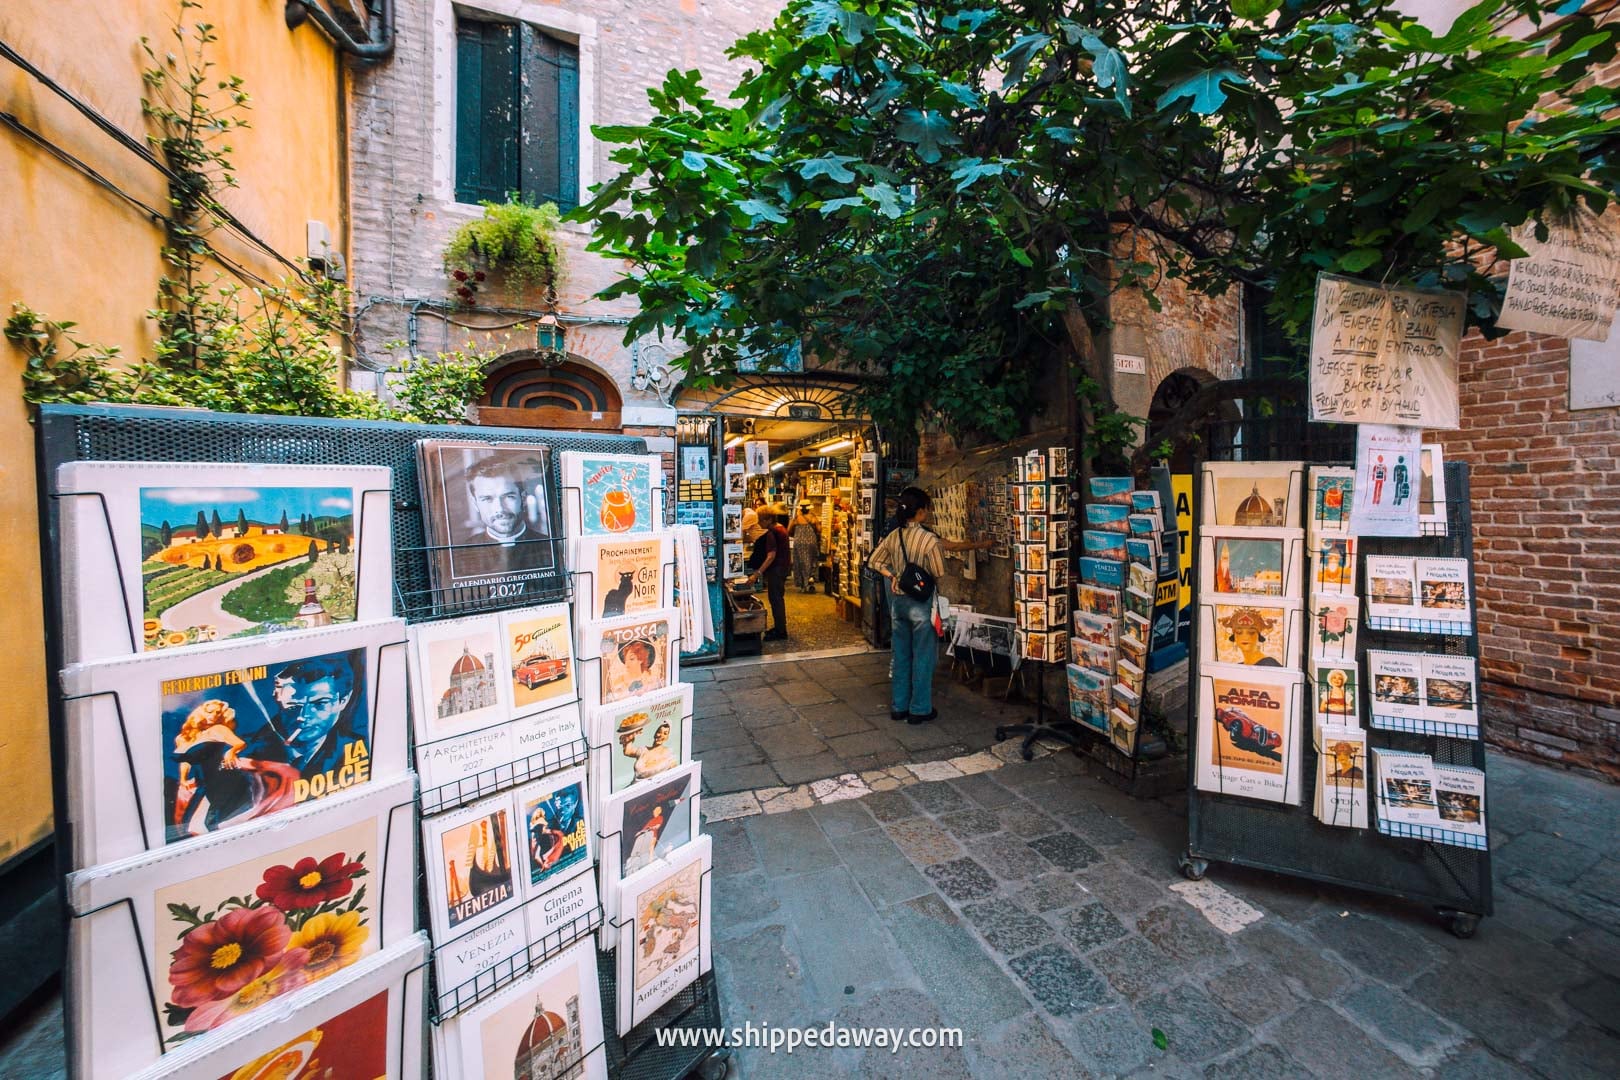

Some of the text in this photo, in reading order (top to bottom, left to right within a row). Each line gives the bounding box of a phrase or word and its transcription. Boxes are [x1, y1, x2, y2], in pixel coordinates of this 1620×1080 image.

[1339, 310, 1382, 332] TENERE
[1333, 331, 1342, 347] A
[1385, 341, 1444, 357] ENTRANDO
[1317, 357, 1358, 377] PLEASE
[1343, 379, 1401, 395] BACKPACK
[600, 546, 653, 560] PROCHAINEMENT
[506, 571, 556, 583] GREGORIANO
[638, 566, 657, 583] CHAT
[489, 582, 525, 599] 2027
[634, 584, 656, 599] NOIR
[1157, 583, 1177, 600] ATM
[614, 622, 657, 642] TOSCA
[1218, 694, 1281, 710] ROMEO
[1227, 687, 1271, 700] ALFA
[519, 720, 576, 745] Made in Italy
[344, 739, 370, 767] LA
[541, 737, 559, 749] 2027
[449, 744, 494, 764] ITALIANA
[463, 759, 484, 771] 2027
[294, 759, 370, 804] DOLCE
[455, 885, 508, 921] VENEZIA
[544, 886, 583, 912] Cinema
[545, 898, 583, 926] Italiano
[456, 929, 515, 964] VENEZIA
[474, 951, 501, 974] 2027
